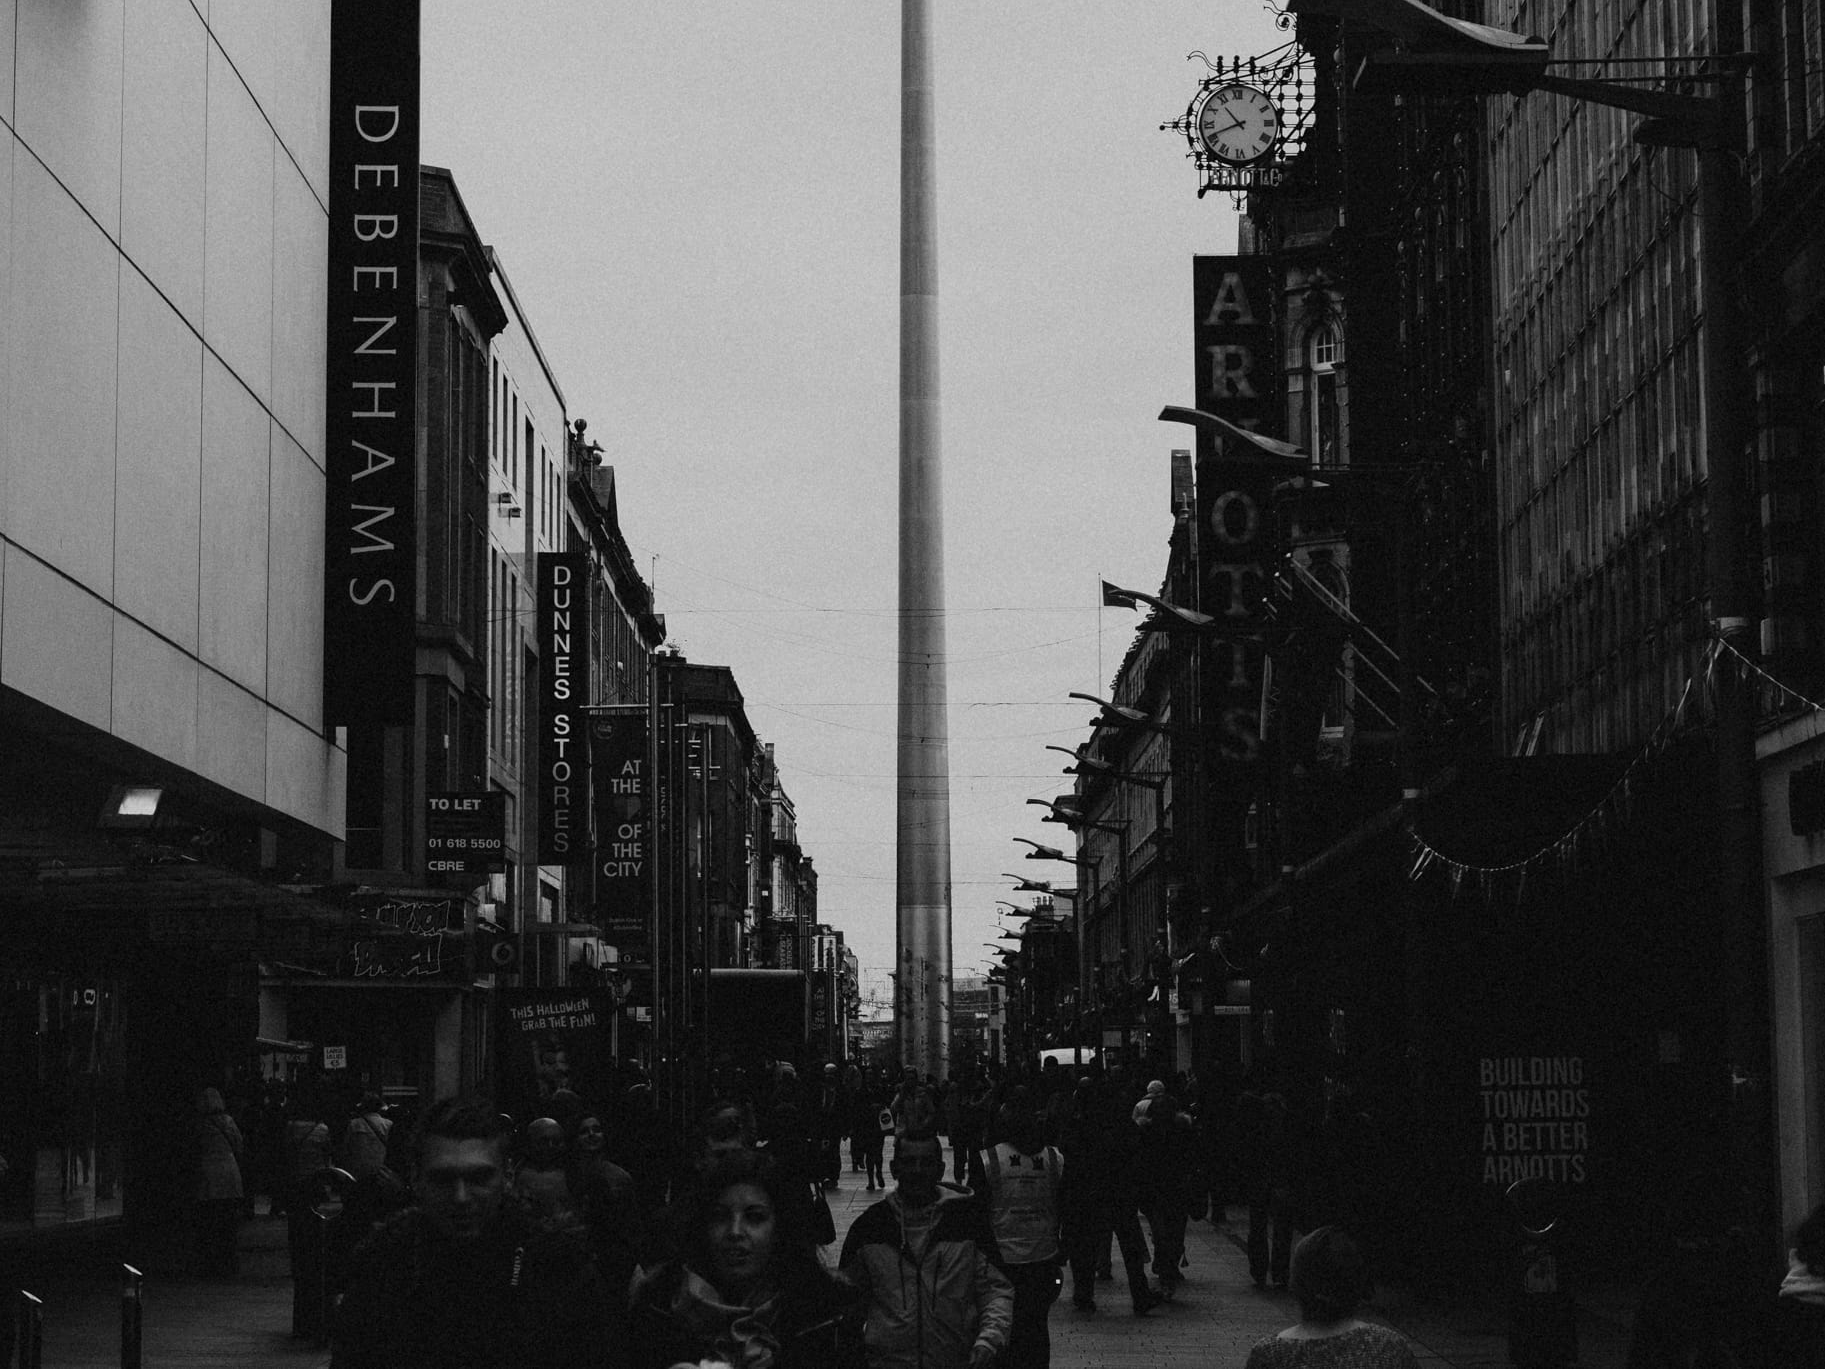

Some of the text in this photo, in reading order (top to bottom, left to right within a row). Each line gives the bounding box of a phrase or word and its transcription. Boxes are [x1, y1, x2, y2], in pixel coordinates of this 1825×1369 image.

[349, 105, 400, 605] DEBENHAMS
[552, 565, 572, 853] DUNNES STORES
[621, 759, 642, 775] AT
[610, 778, 641, 794] THE
[429, 798, 482, 811] TO LET
[617, 823, 642, 840] OF
[428, 838, 501, 849] 01 618 5500
[611, 842, 642, 858] THE
[427, 860, 465, 872] CBRE
[603, 861, 643, 878] CITY
[509, 1005, 534, 1020] THIS
[521, 1012, 597, 1031] GRAB THE FUN!
[1480, 1056, 1584, 1087] BUILDING
[1480, 1089, 1590, 1119] TOWARDS
[1482, 1121, 1589, 1152] A BETTER
[1482, 1153, 1586, 1184] ARNOTTS
